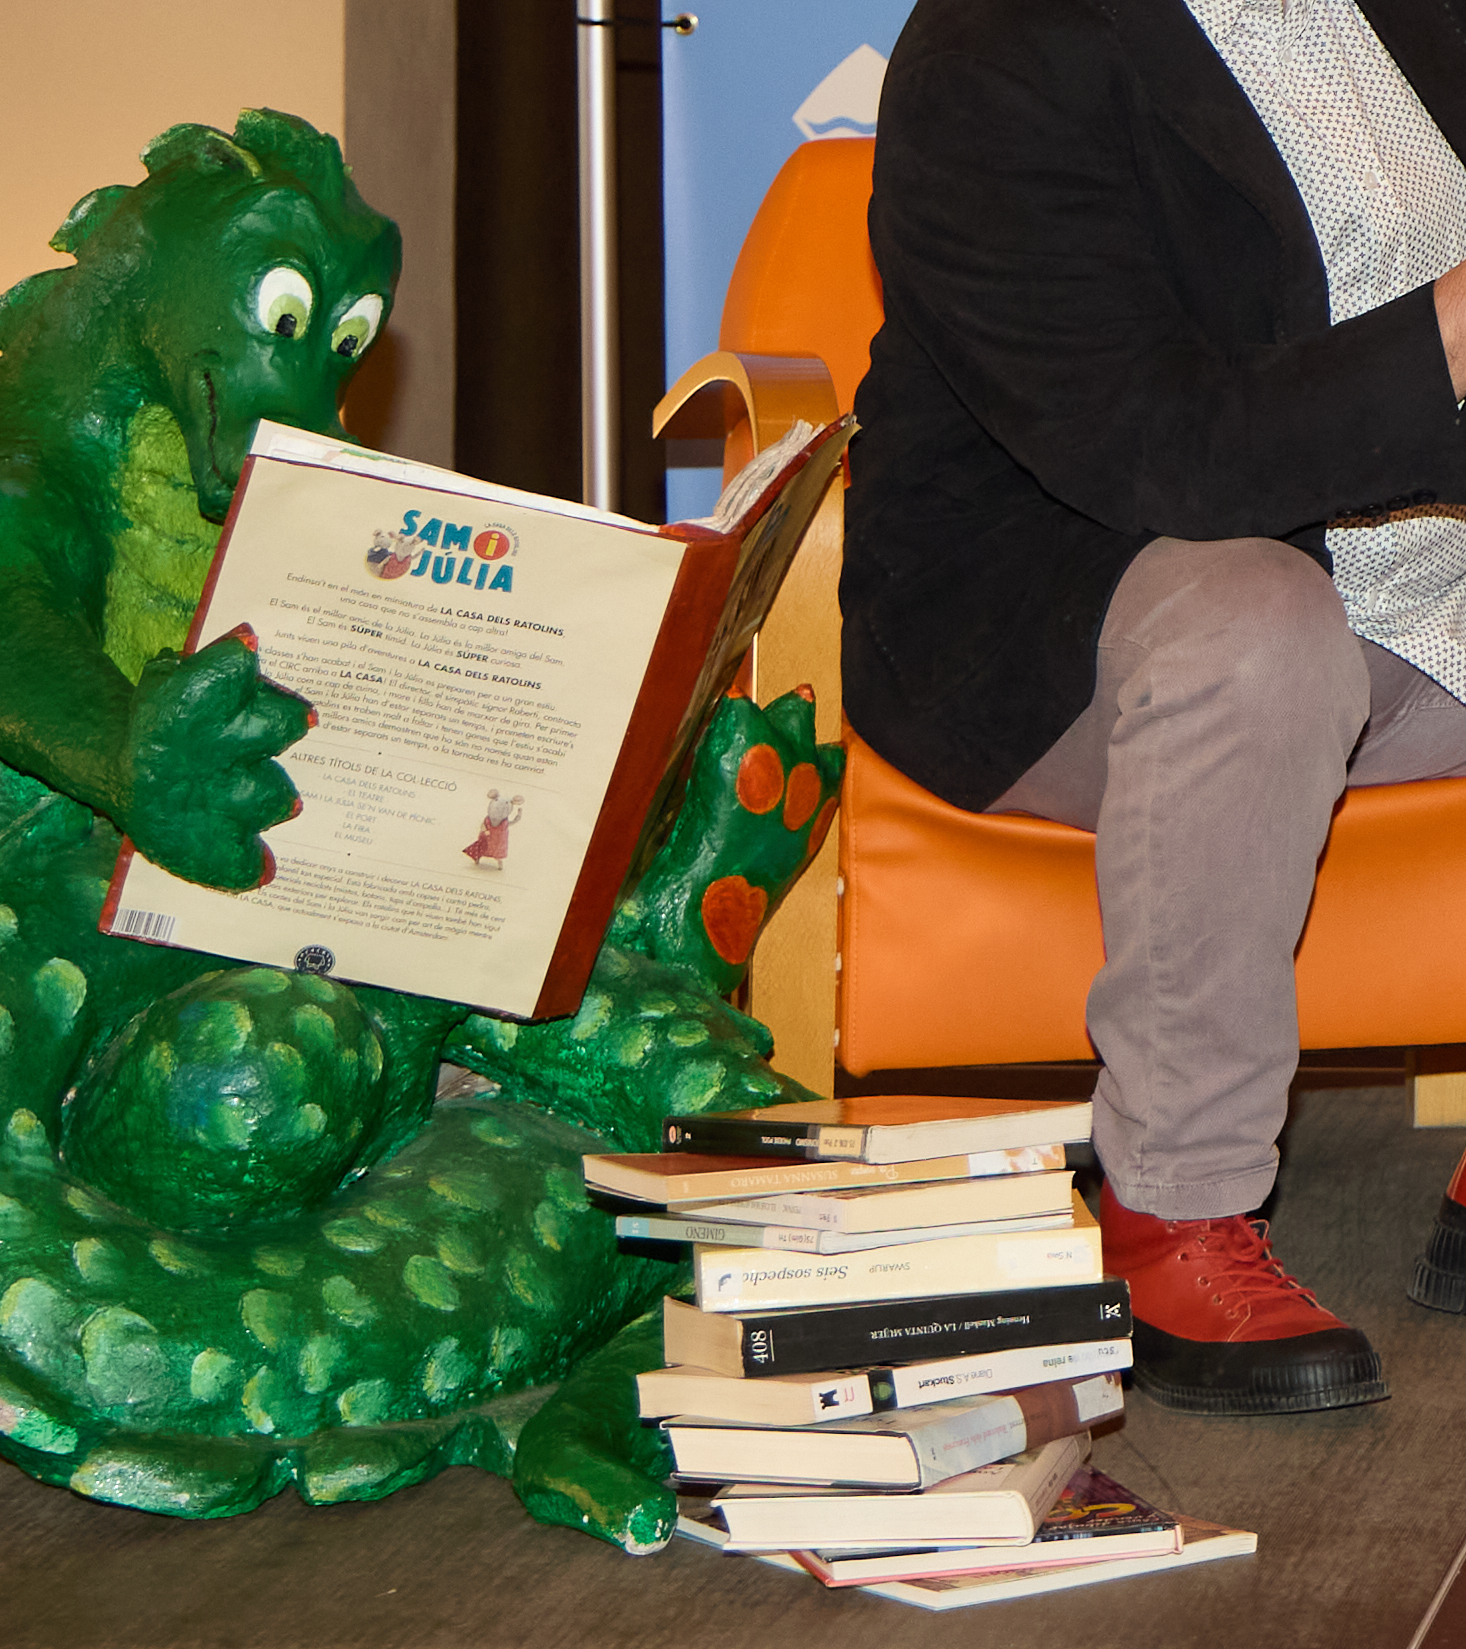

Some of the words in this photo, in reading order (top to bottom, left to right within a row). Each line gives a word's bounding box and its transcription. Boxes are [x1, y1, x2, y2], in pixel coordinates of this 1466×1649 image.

[399, 509, 473, 551] SAM
[410, 550, 514, 593] JÚLIA
[327, 583, 339, 591] en
[426, 604, 438, 614] de
[440, 607, 453, 616] LA
[456, 609, 483, 621] CASA
[486, 614, 511, 625] DELS
[317, 617, 336, 628] Sam
[350, 623, 383, 640] SÚPER
[455, 649, 489, 663] SÚPER
[730, 1174, 782, 1188] TAMARO
[782, 1168, 839, 1183] SUSANNA
[685, 1226, 726, 1241] GIMENO
[816, 1265, 849, 1281] Seis
[868, 1261, 911, 1274] SWARUP
[904, 1322, 943, 1336] QUINTA
[941, 1323, 957, 1332] LA
[751, 1329, 770, 1365] 408
